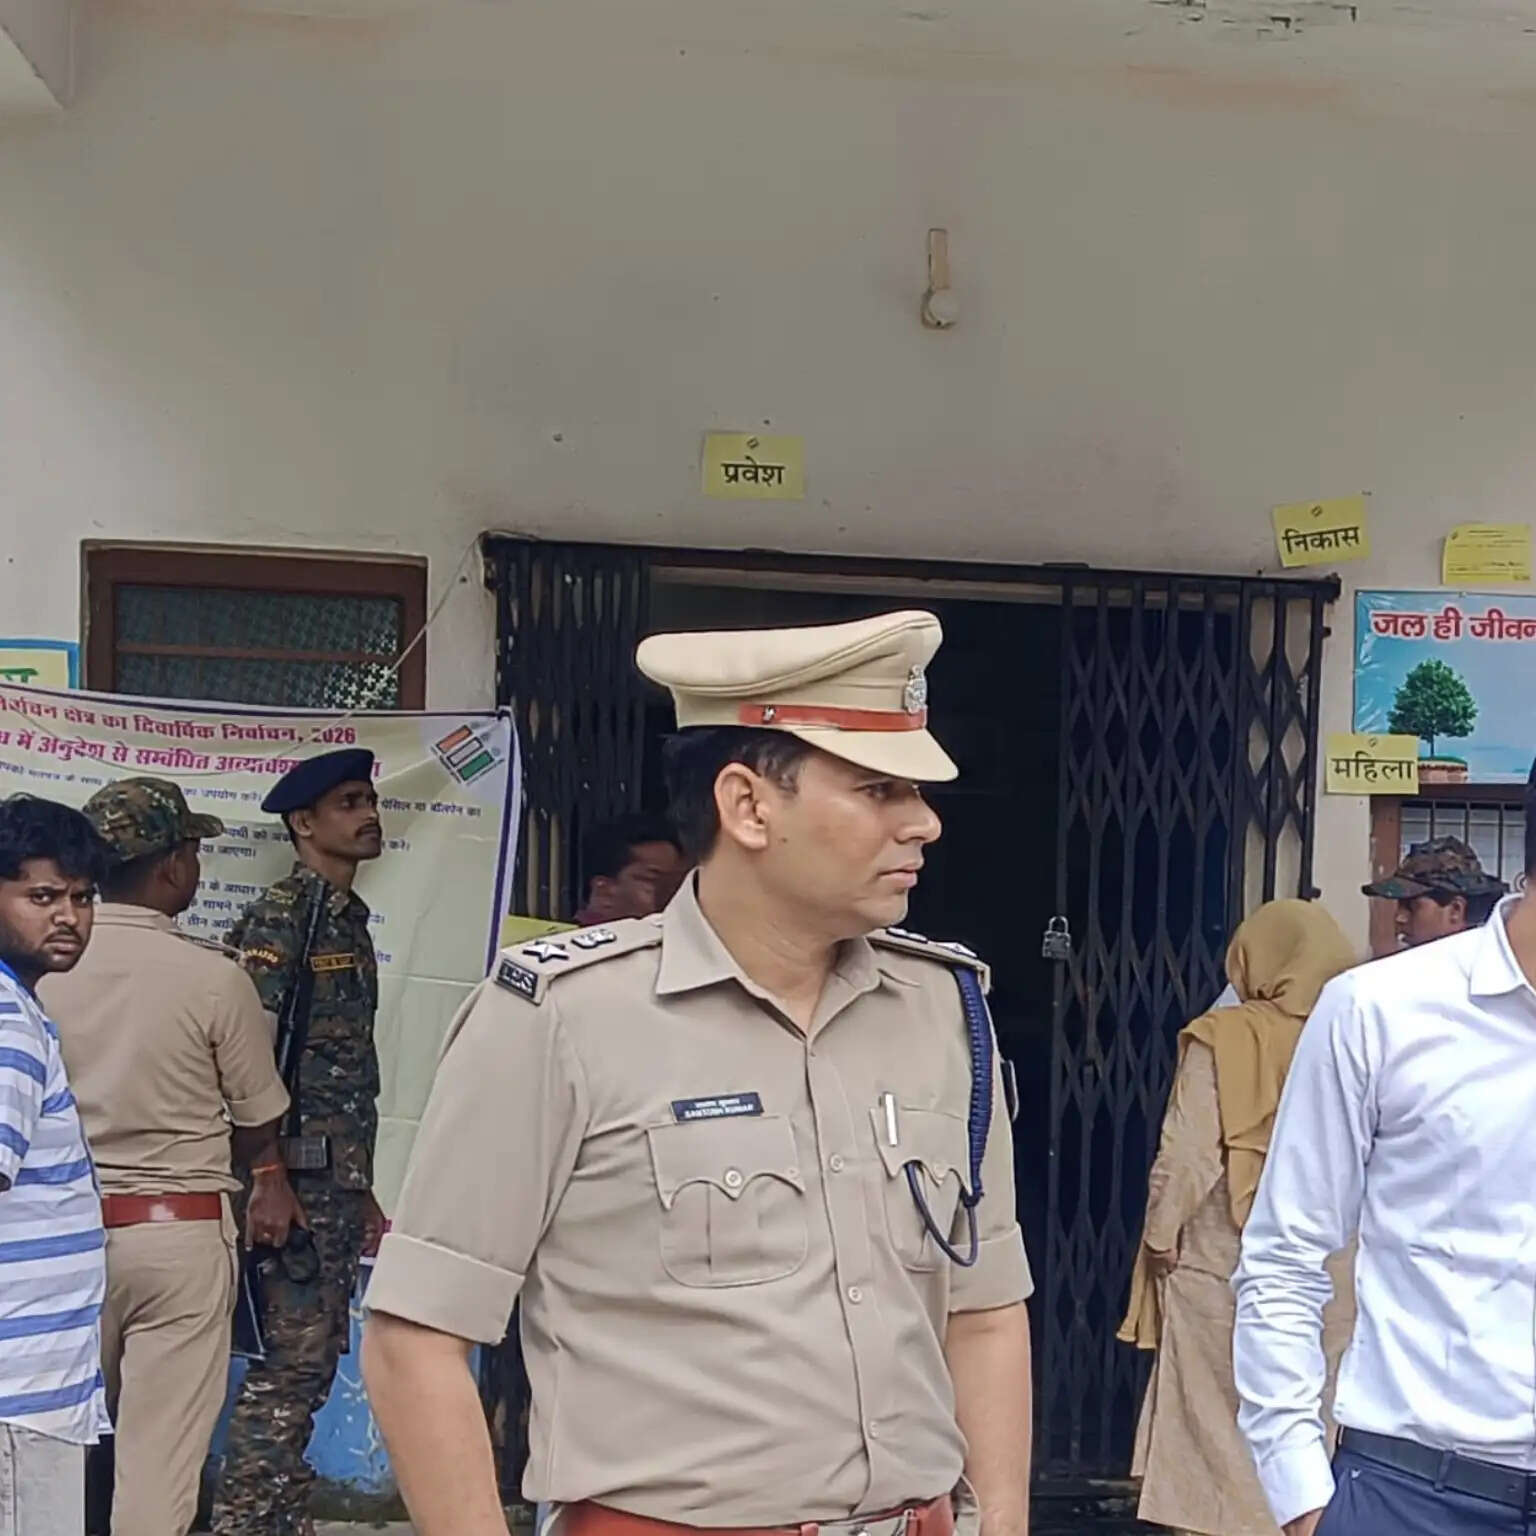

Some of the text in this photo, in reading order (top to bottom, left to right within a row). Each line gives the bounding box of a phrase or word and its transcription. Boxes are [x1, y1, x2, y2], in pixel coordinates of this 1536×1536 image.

[721, 456, 786, 486] प्रवेश
[1282, 525, 1360, 555] निकास
[1373, 611, 1425, 638] जल
[1434, 606, 1462, 640] ही
[102, 714, 127, 731] का
[112, 742, 128, 763] से
[1332, 750, 1414, 782] महिला
